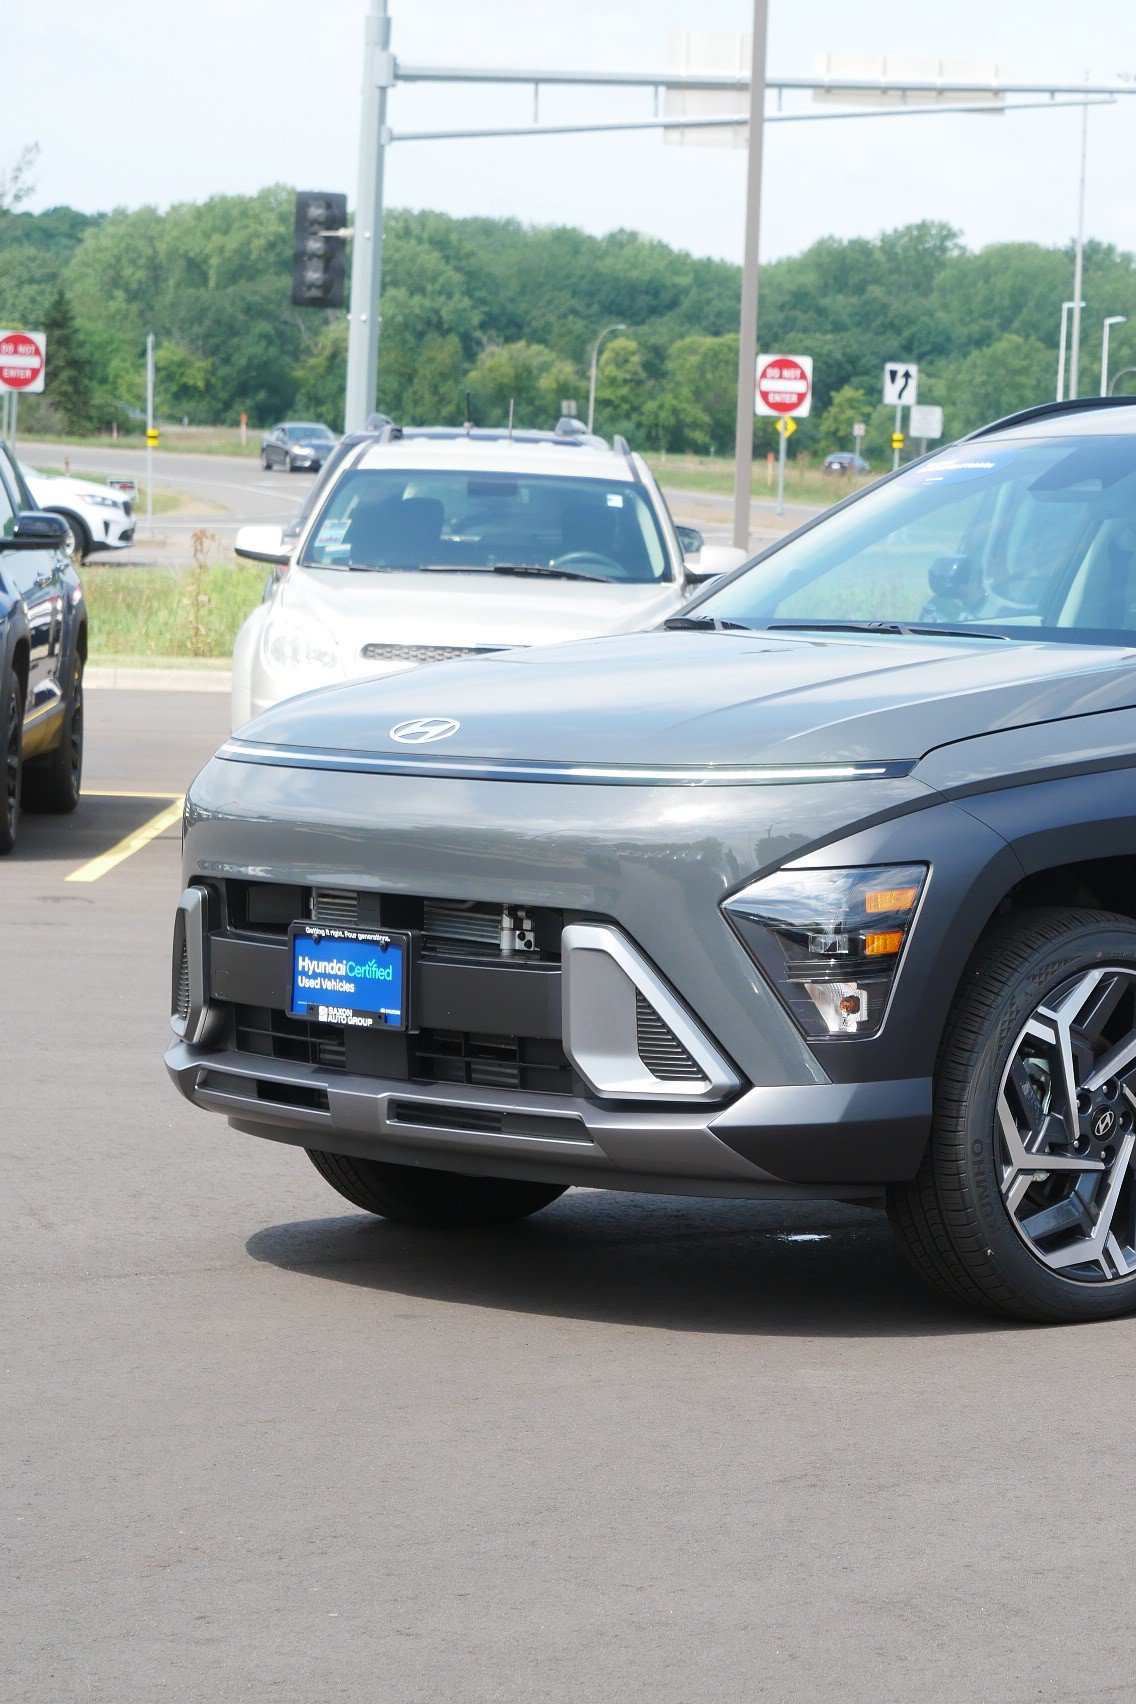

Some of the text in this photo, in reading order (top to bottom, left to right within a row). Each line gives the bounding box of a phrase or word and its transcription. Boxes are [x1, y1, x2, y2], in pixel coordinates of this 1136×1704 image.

[1, 343, 35, 354] DO NOT
[3, 368, 32, 379] ENTER
[766, 367, 801, 379] DO NOT
[768, 393, 798, 404] ENTER
[305, 927, 325, 937] Getting
[345, 931, 357, 939] Four
[298, 956, 392, 980] Hyundai Certified
[298, 976, 355, 993] Used Vehicles
[328, 1007, 352, 1016] SAXON
[327, 1015, 373, 1026] AUTO GROUP
